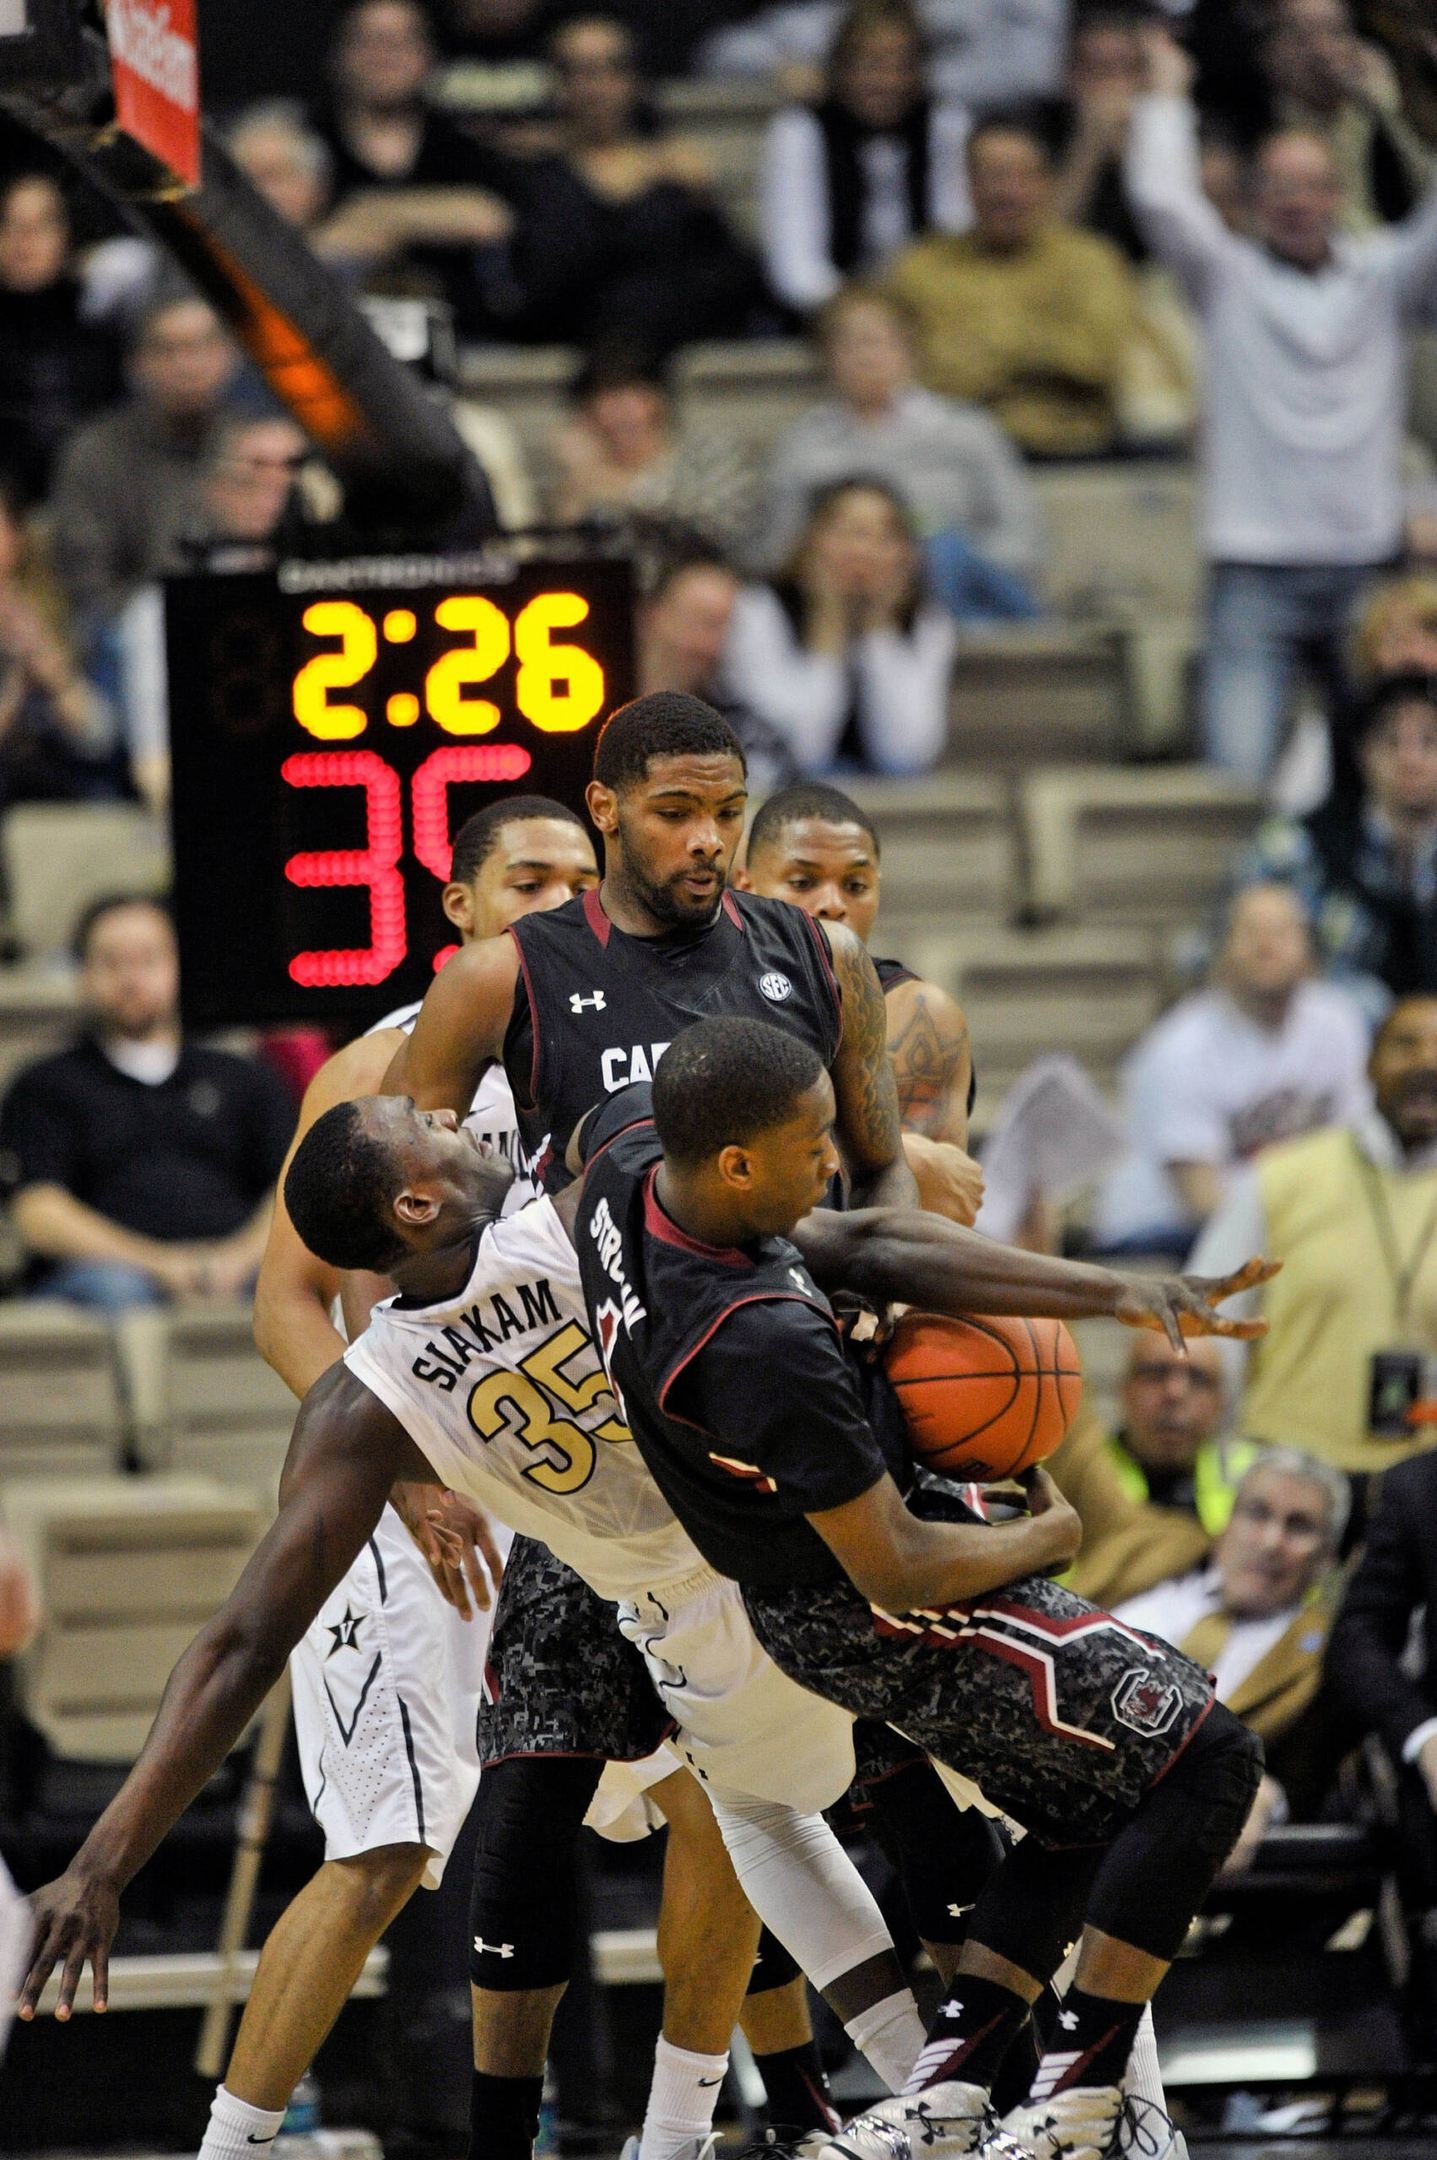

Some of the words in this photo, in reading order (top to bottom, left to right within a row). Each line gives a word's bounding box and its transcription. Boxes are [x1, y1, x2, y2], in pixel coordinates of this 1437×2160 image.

[292, 592, 605, 741] 2:26
[762, 973, 791, 1000] SEC
[411, 1278, 563, 1393] SIAKAM
[466, 1317, 635, 1496] 35
